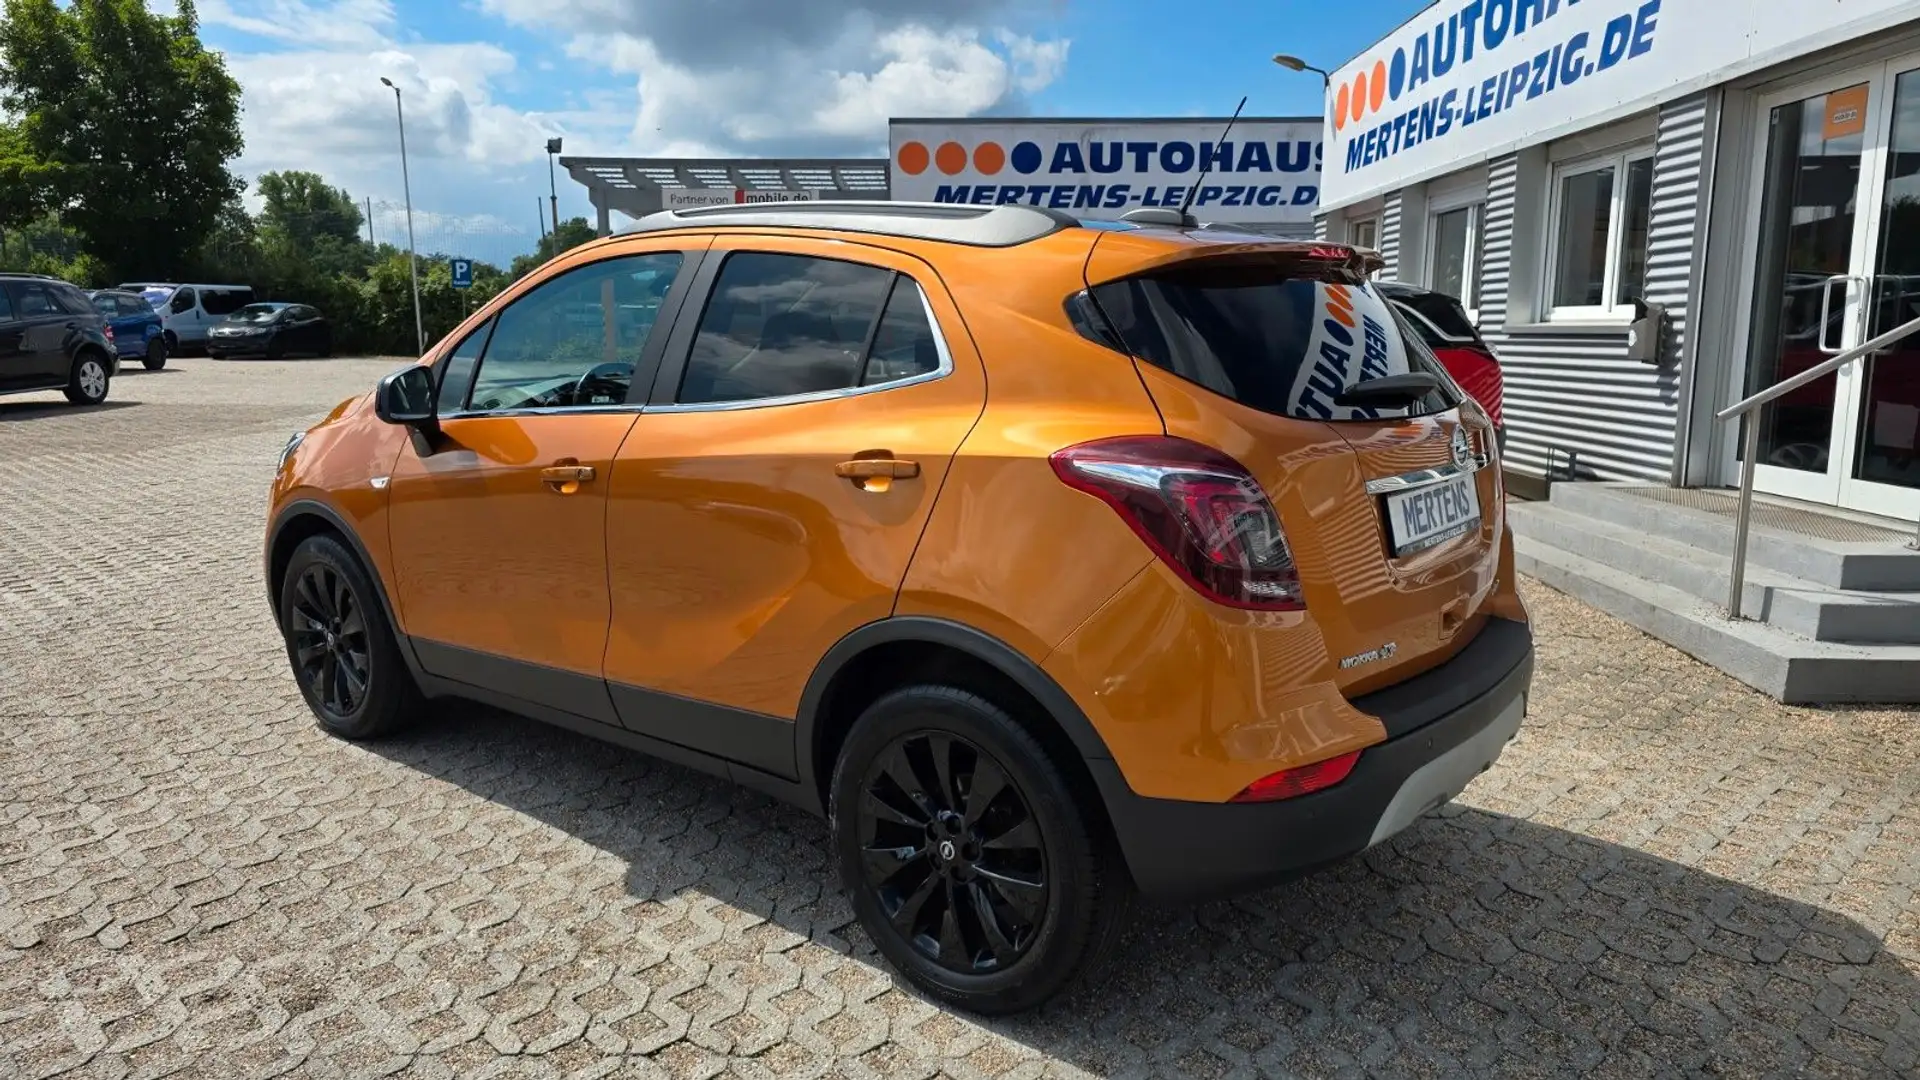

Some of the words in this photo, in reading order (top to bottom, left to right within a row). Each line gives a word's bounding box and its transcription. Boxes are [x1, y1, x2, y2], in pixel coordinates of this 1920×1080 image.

[1407, 0, 1580, 93] AUTOH
[1345, 0, 1662, 174] MERTENS-LEIPZIG.DE
[670, 193, 709, 205] Partner
[710, 195, 729, 205] von
[933, 184, 1320, 208] MERTENS-LEIPZIG.D
[455, 261, 468, 279] P
[1401, 479, 1471, 539] MERTENS
